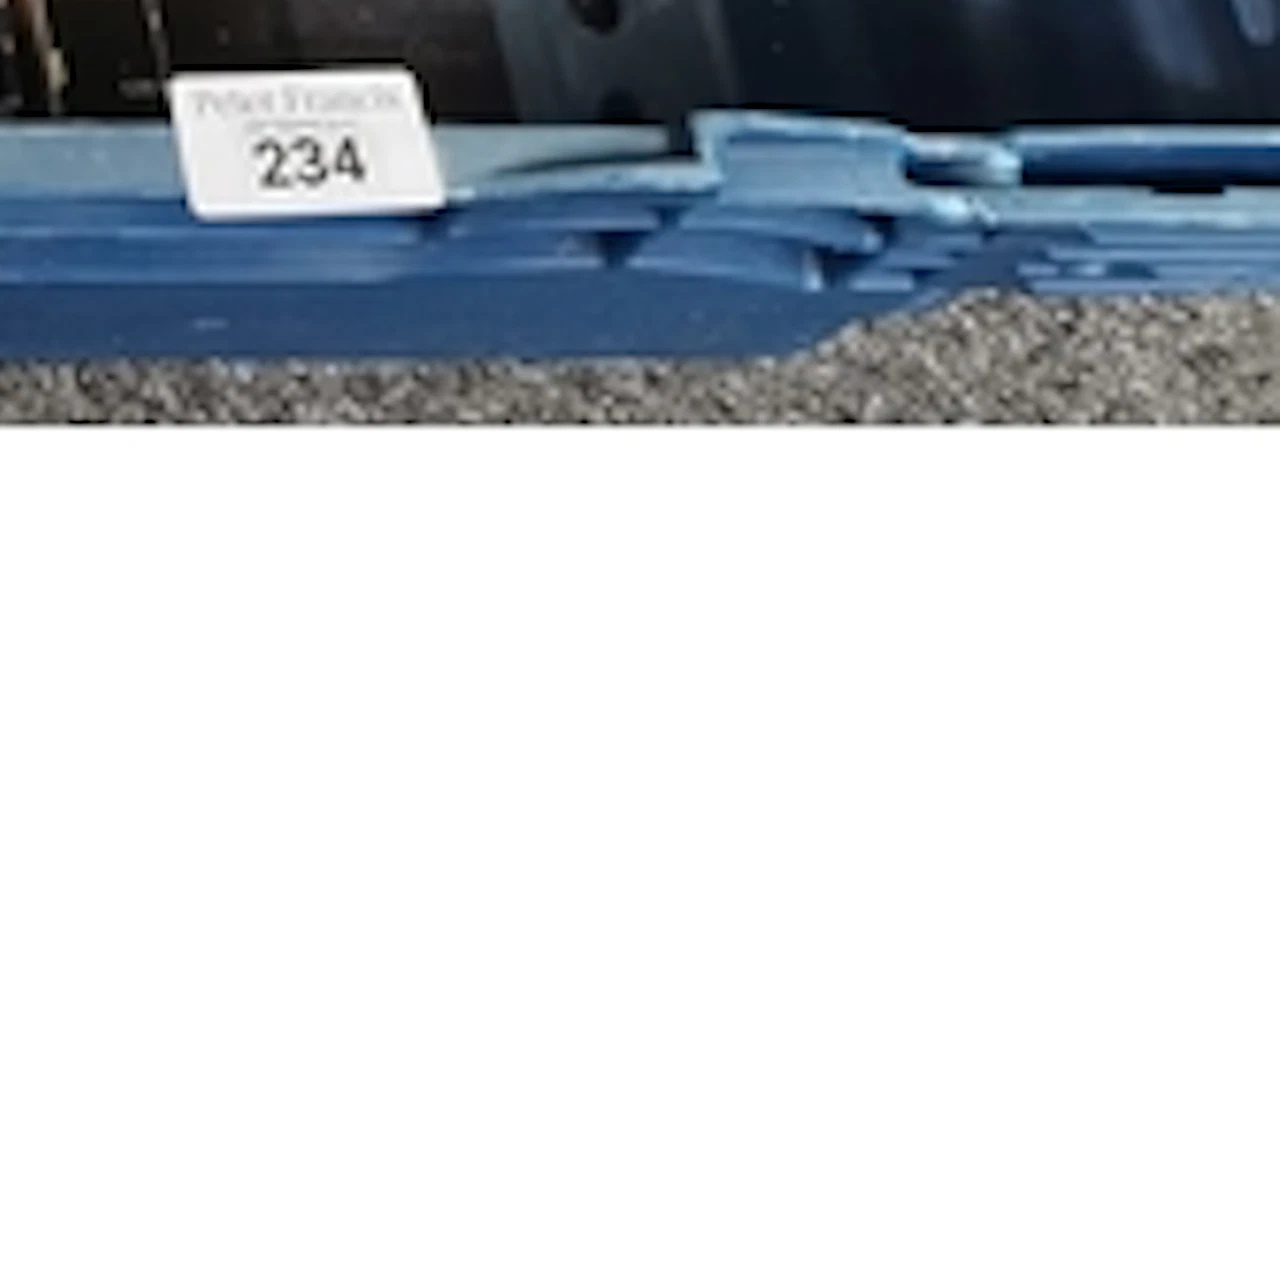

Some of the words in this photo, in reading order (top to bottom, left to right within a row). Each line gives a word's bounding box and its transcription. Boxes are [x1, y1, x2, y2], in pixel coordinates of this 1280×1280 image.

[192, 86, 277, 116] Peter
[280, 83, 403, 113] Francis
[252, 135, 367, 190] 234
